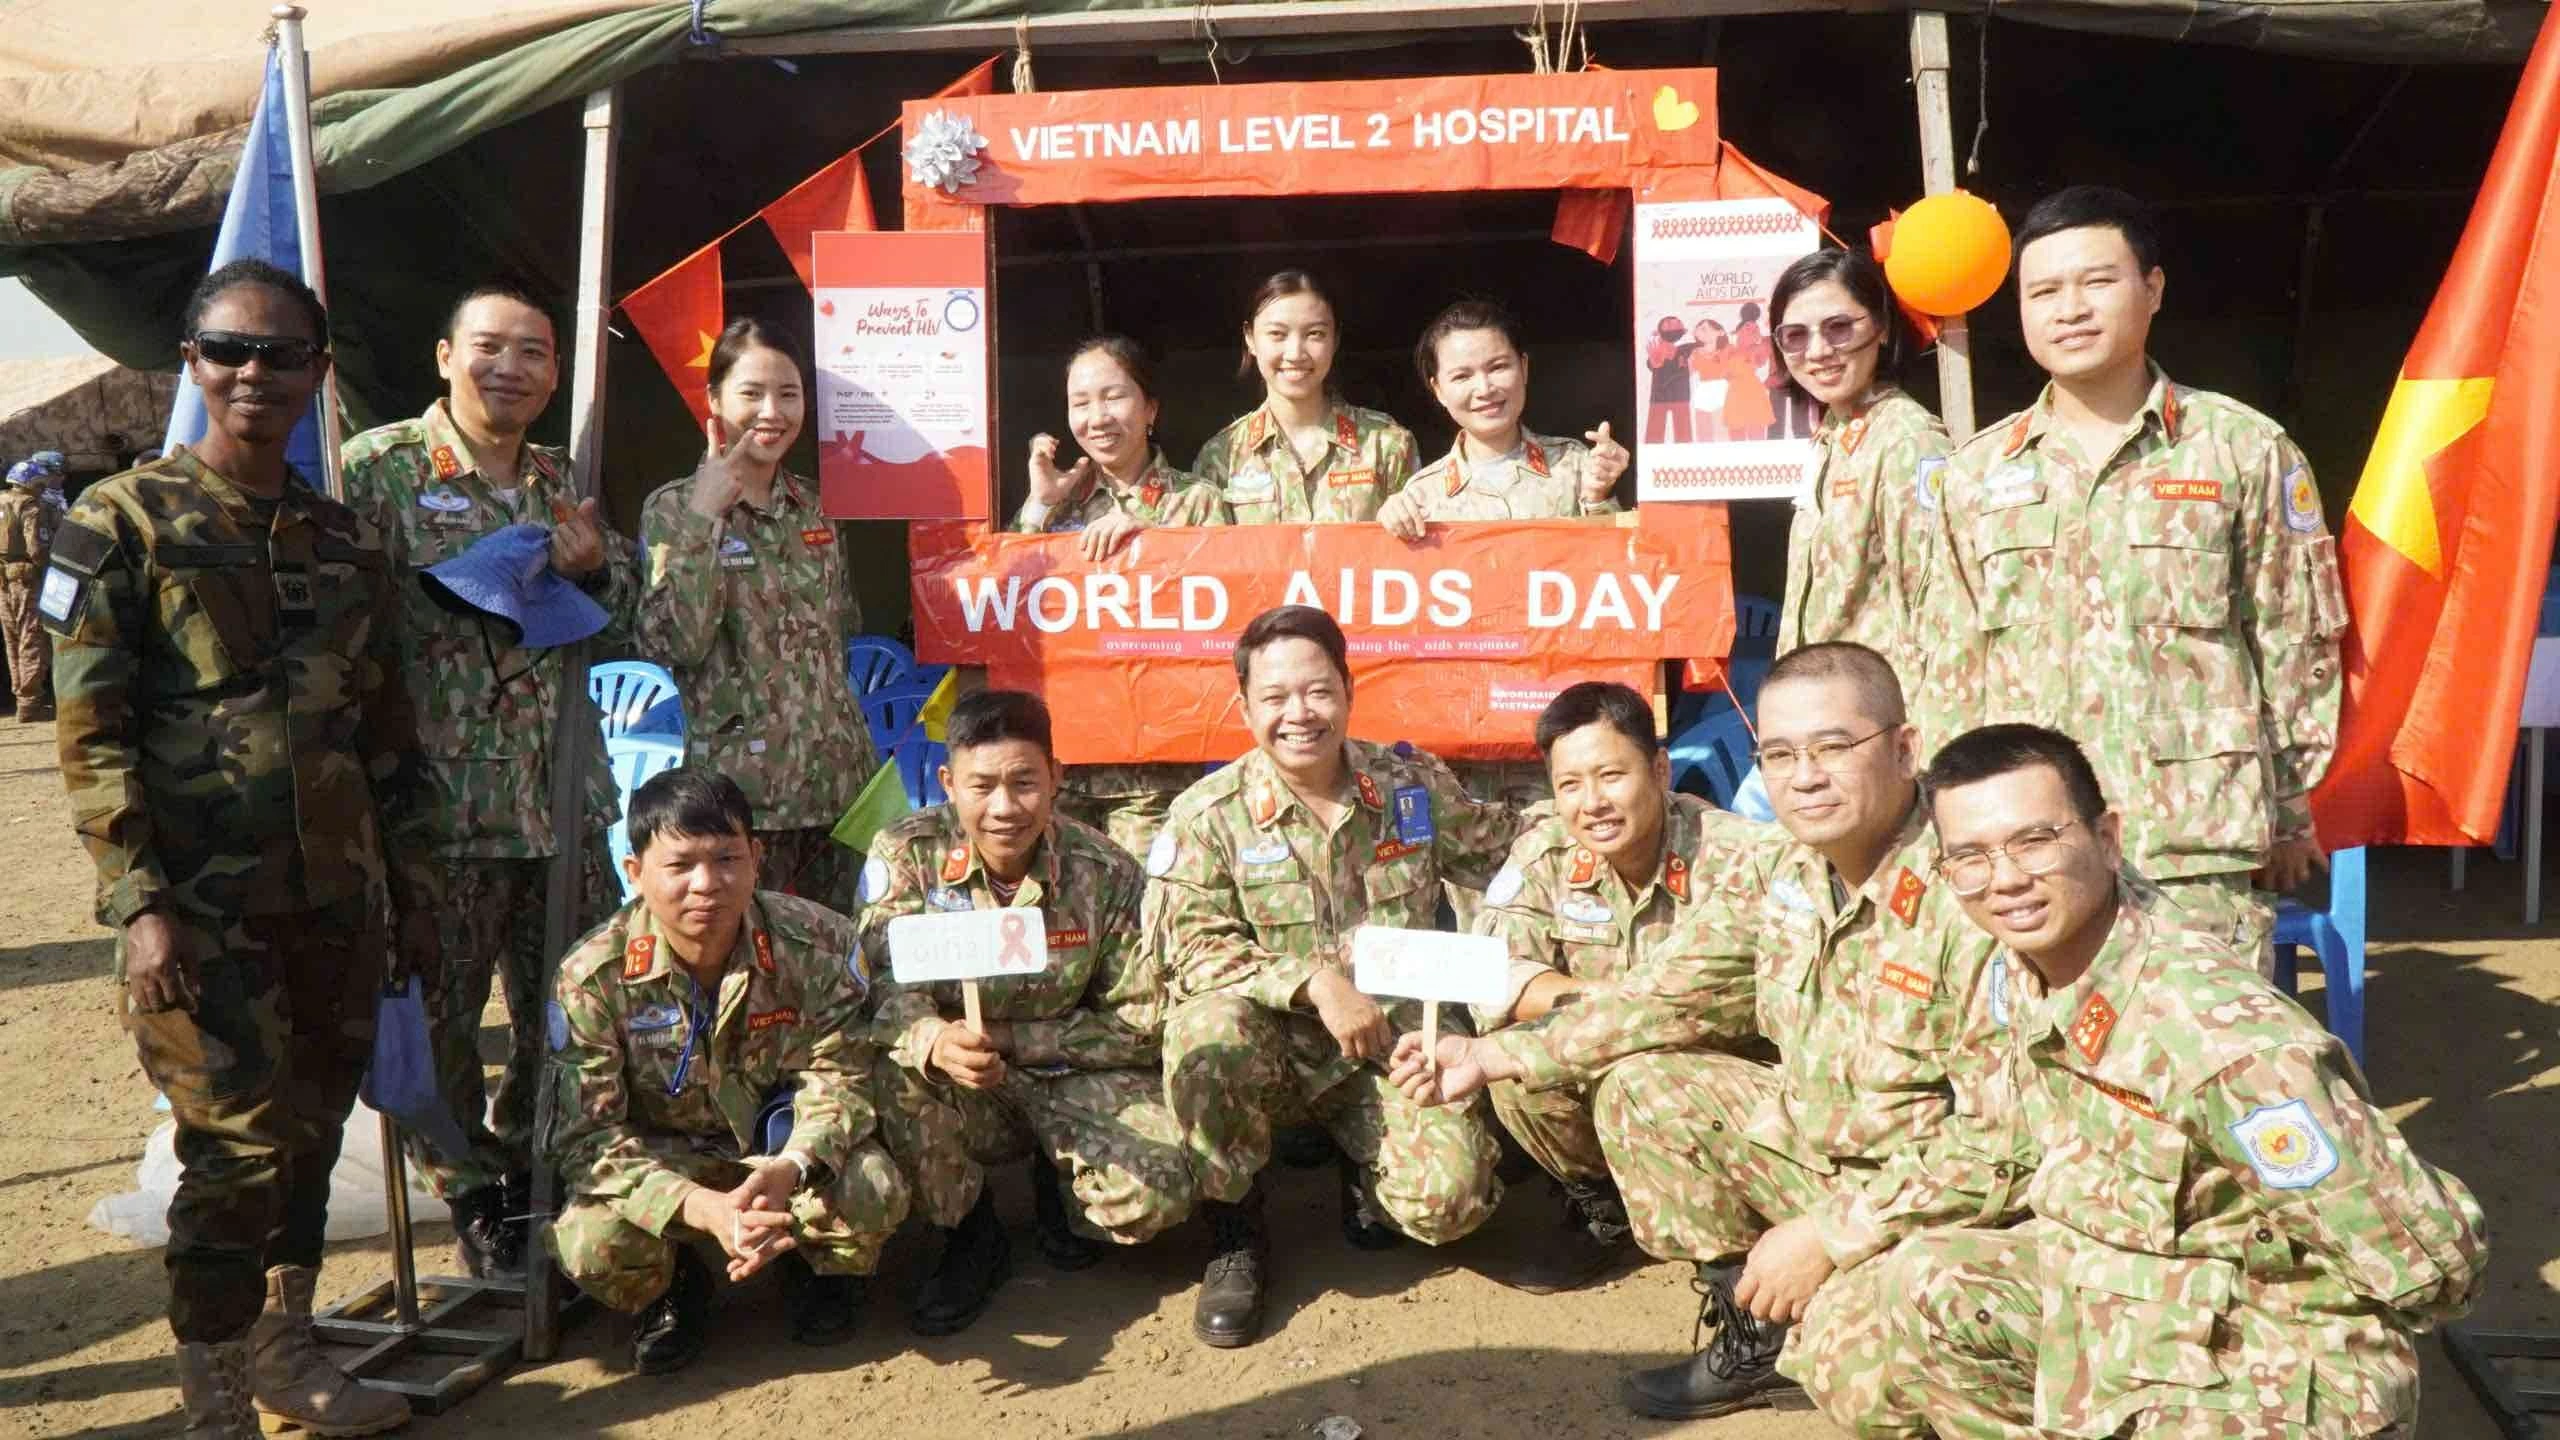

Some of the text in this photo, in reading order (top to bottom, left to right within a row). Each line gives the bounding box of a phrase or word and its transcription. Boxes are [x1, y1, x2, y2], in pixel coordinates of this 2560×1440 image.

[1010, 106, 1629, 161] VIETNAM LEVEL 2 HOSPITAL
[1700, 272, 1752, 285] WORLD
[1696, 285, 1759, 298] AIDS DAY
[867, 297, 929, 321] Ways To
[856, 317, 914, 336] Prevent
[2157, 484, 2216, 497] VIET NAM
[955, 567, 1681, 633] WORLD AIDS DAY
[1106, 639, 1182, 654] overcoming
[1201, 637, 1235, 650] disru
[1457, 639, 1520, 653] response
